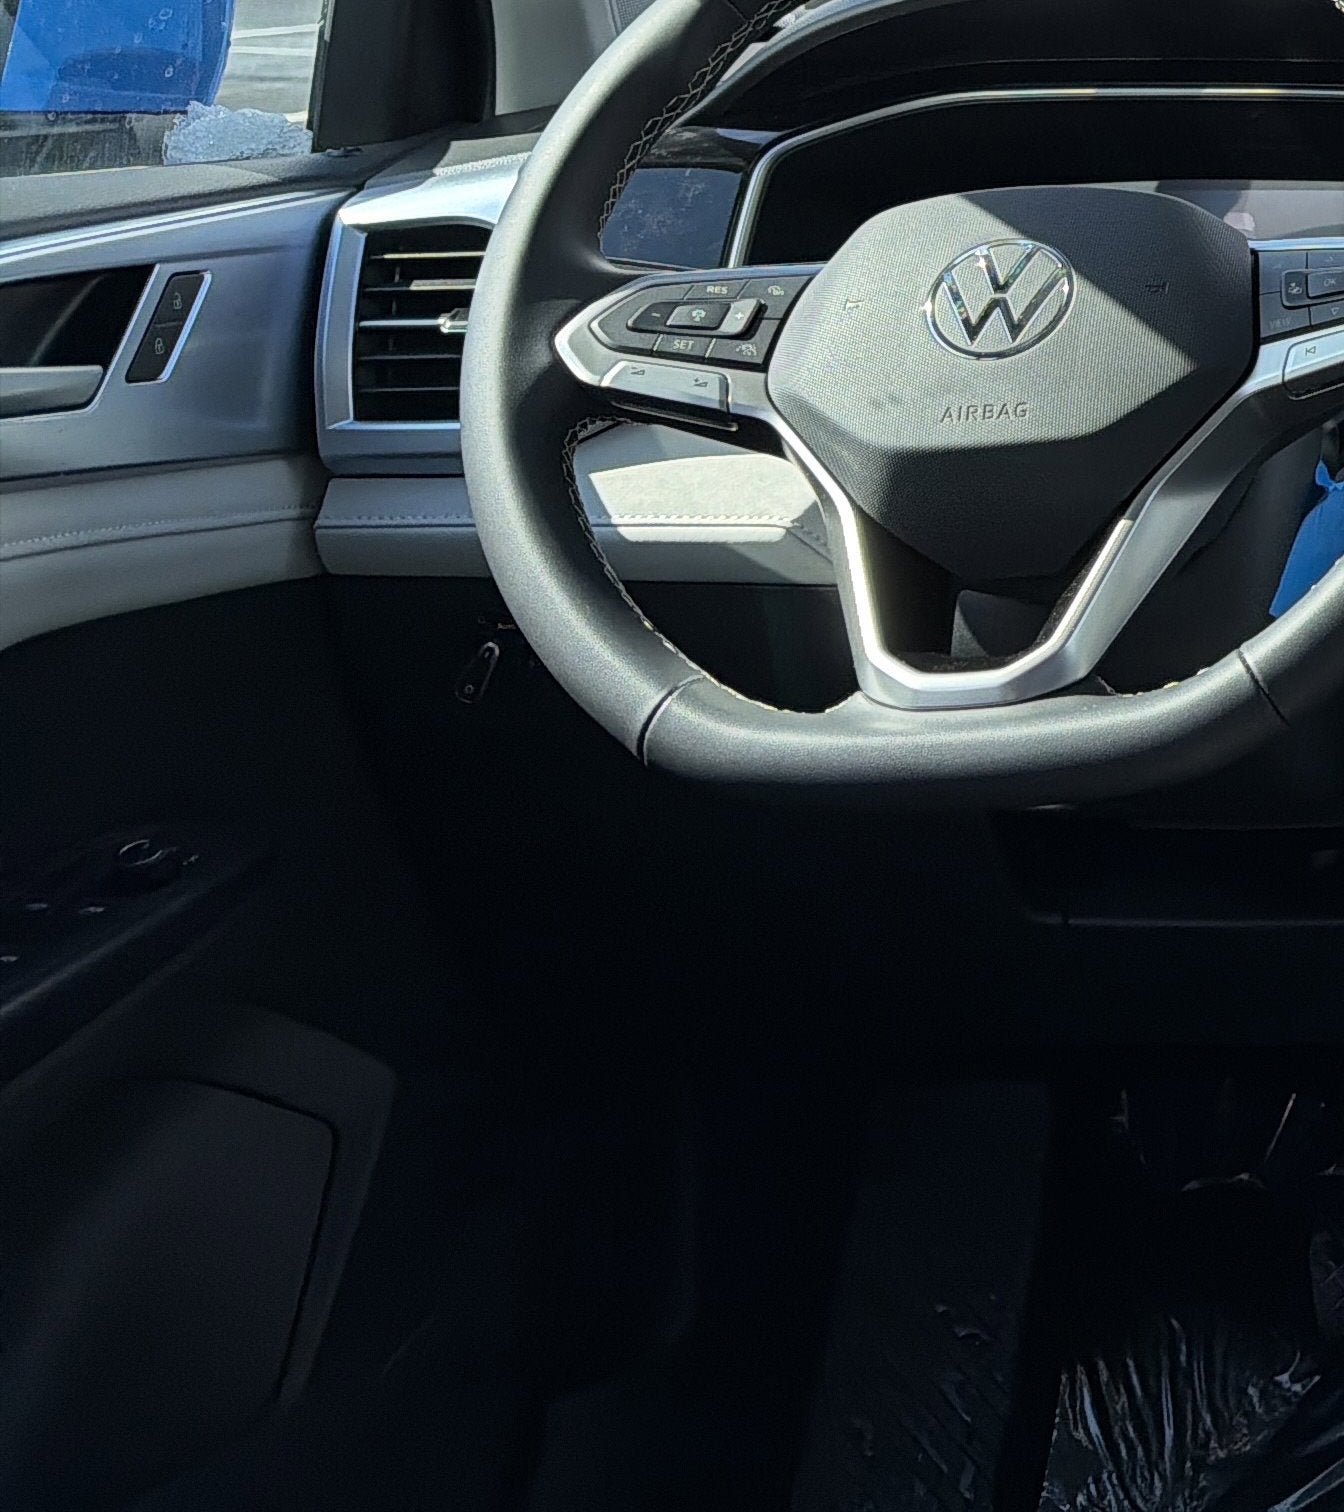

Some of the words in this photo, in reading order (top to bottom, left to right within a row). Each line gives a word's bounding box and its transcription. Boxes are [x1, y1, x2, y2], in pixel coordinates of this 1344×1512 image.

[706, 286, 728, 294] RES
[673, 339, 694, 350] SET
[940, 401, 1030, 424] AIRBAG
